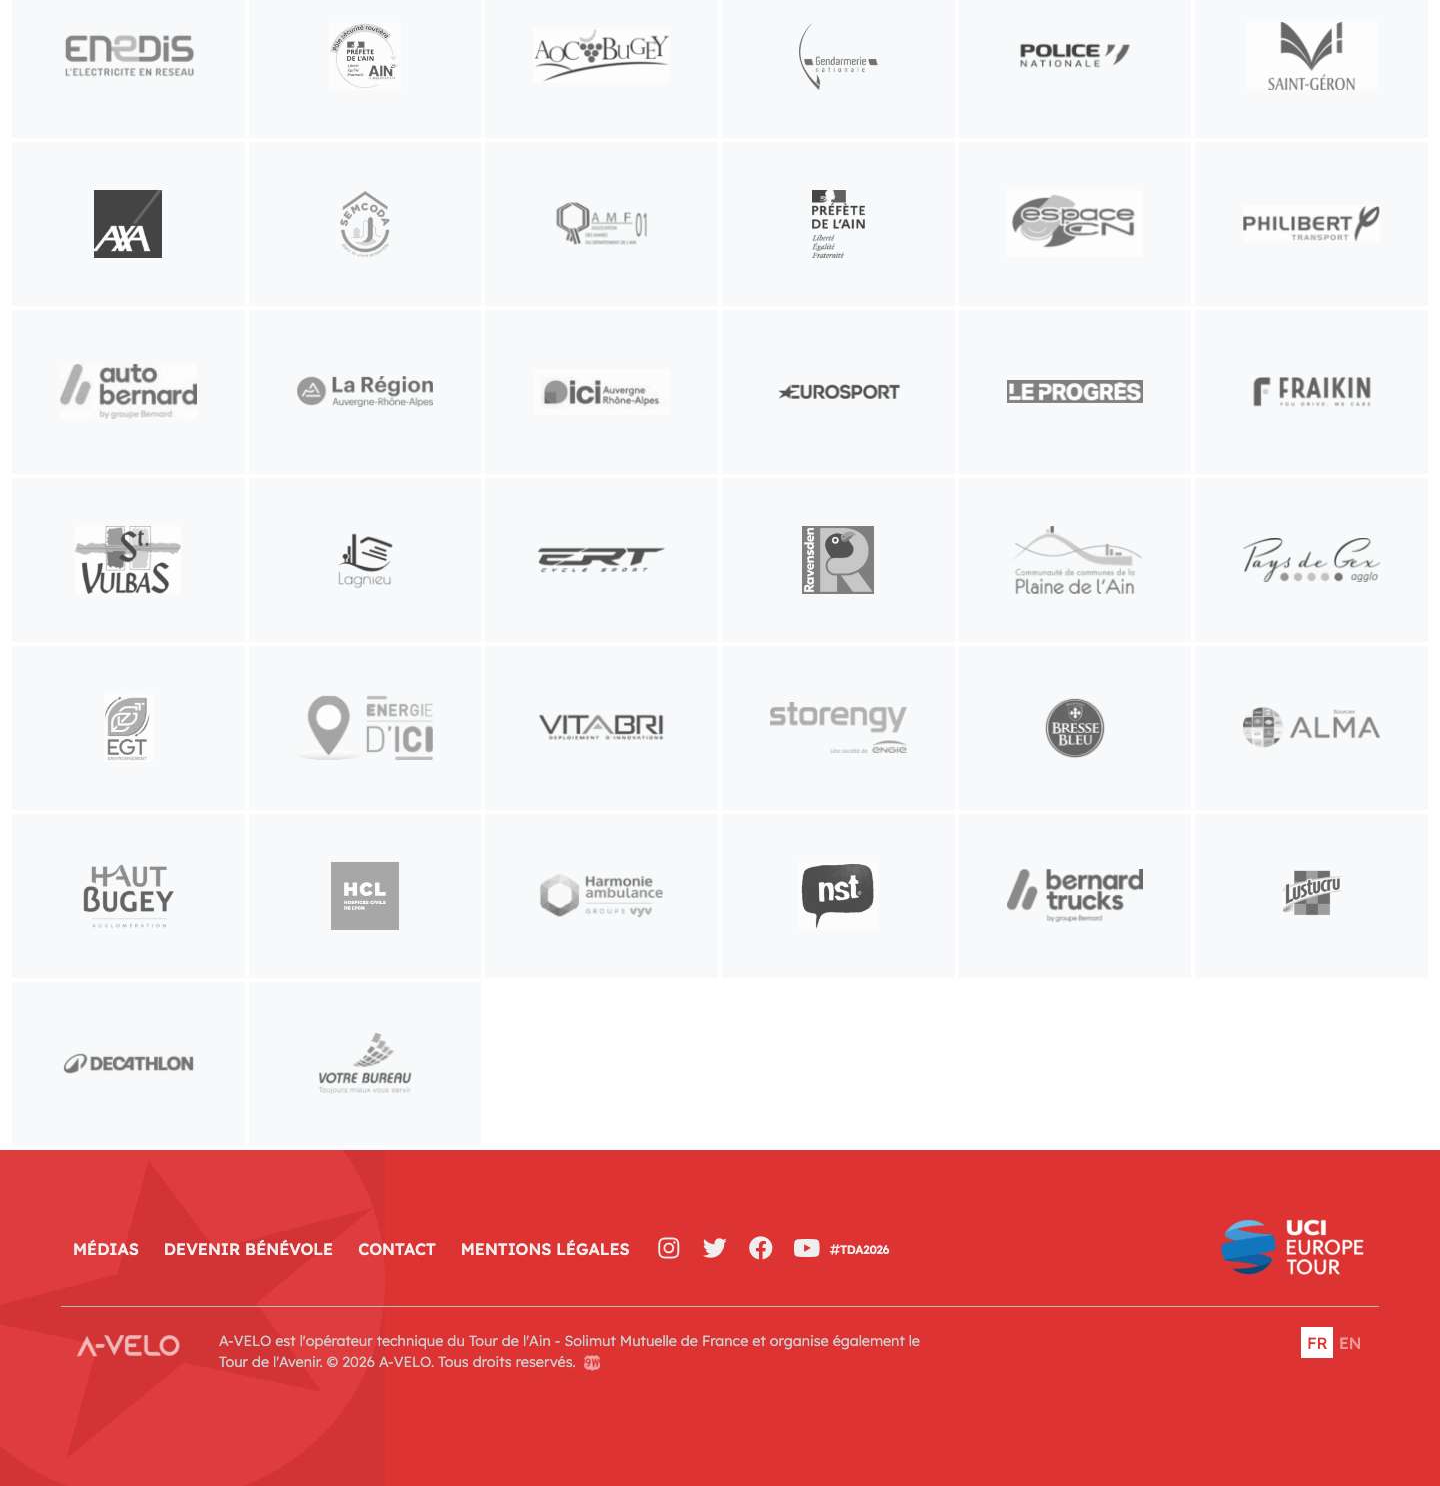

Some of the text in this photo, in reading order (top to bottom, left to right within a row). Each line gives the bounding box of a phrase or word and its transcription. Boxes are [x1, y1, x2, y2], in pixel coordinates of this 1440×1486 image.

[1021, 44, 1100, 57] POLICE
[1268, 74, 1355, 90] SAINT-GÉRON
[1243, 216, 1352, 231] PHILIBERT
[93, 224, 152, 252] AXA
[1280, 377, 1370, 398] FRAIKIN
[803, 526, 817, 593] Ravensden
[338, 571, 391, 588] Lagnieu
[1016, 579, 1064, 594] Plaine
[1069, 579, 1091, 594] de
[540, 715, 663, 734] VITABRI
[770, 702, 907, 733] storengy
[1290, 717, 1380, 738] ALMA
[586, 876, 652, 887] Harmonie
[1046, 869, 1143, 892] bernard
[344, 882, 386, 898] HCL
[586, 886, 663, 898] ambulance
[1284, 875, 1342, 905] Lustucru
[1046, 889, 1123, 910] trucks
[88, 1054, 196, 1074] DECATHLON
[1287, 1220, 1326, 1235] UCI
[74, 1240, 138, 1255] MÉDIAS
[165, 1240, 332, 1255] DEVENIR BÉNÉVOLE
[359, 1243, 435, 1255] CONTACT
[1287, 1240, 1363, 1255] EUROPE
[1287, 1259, 1339, 1275] TOUR
[77, 1335, 179, 1356] A-VELO
